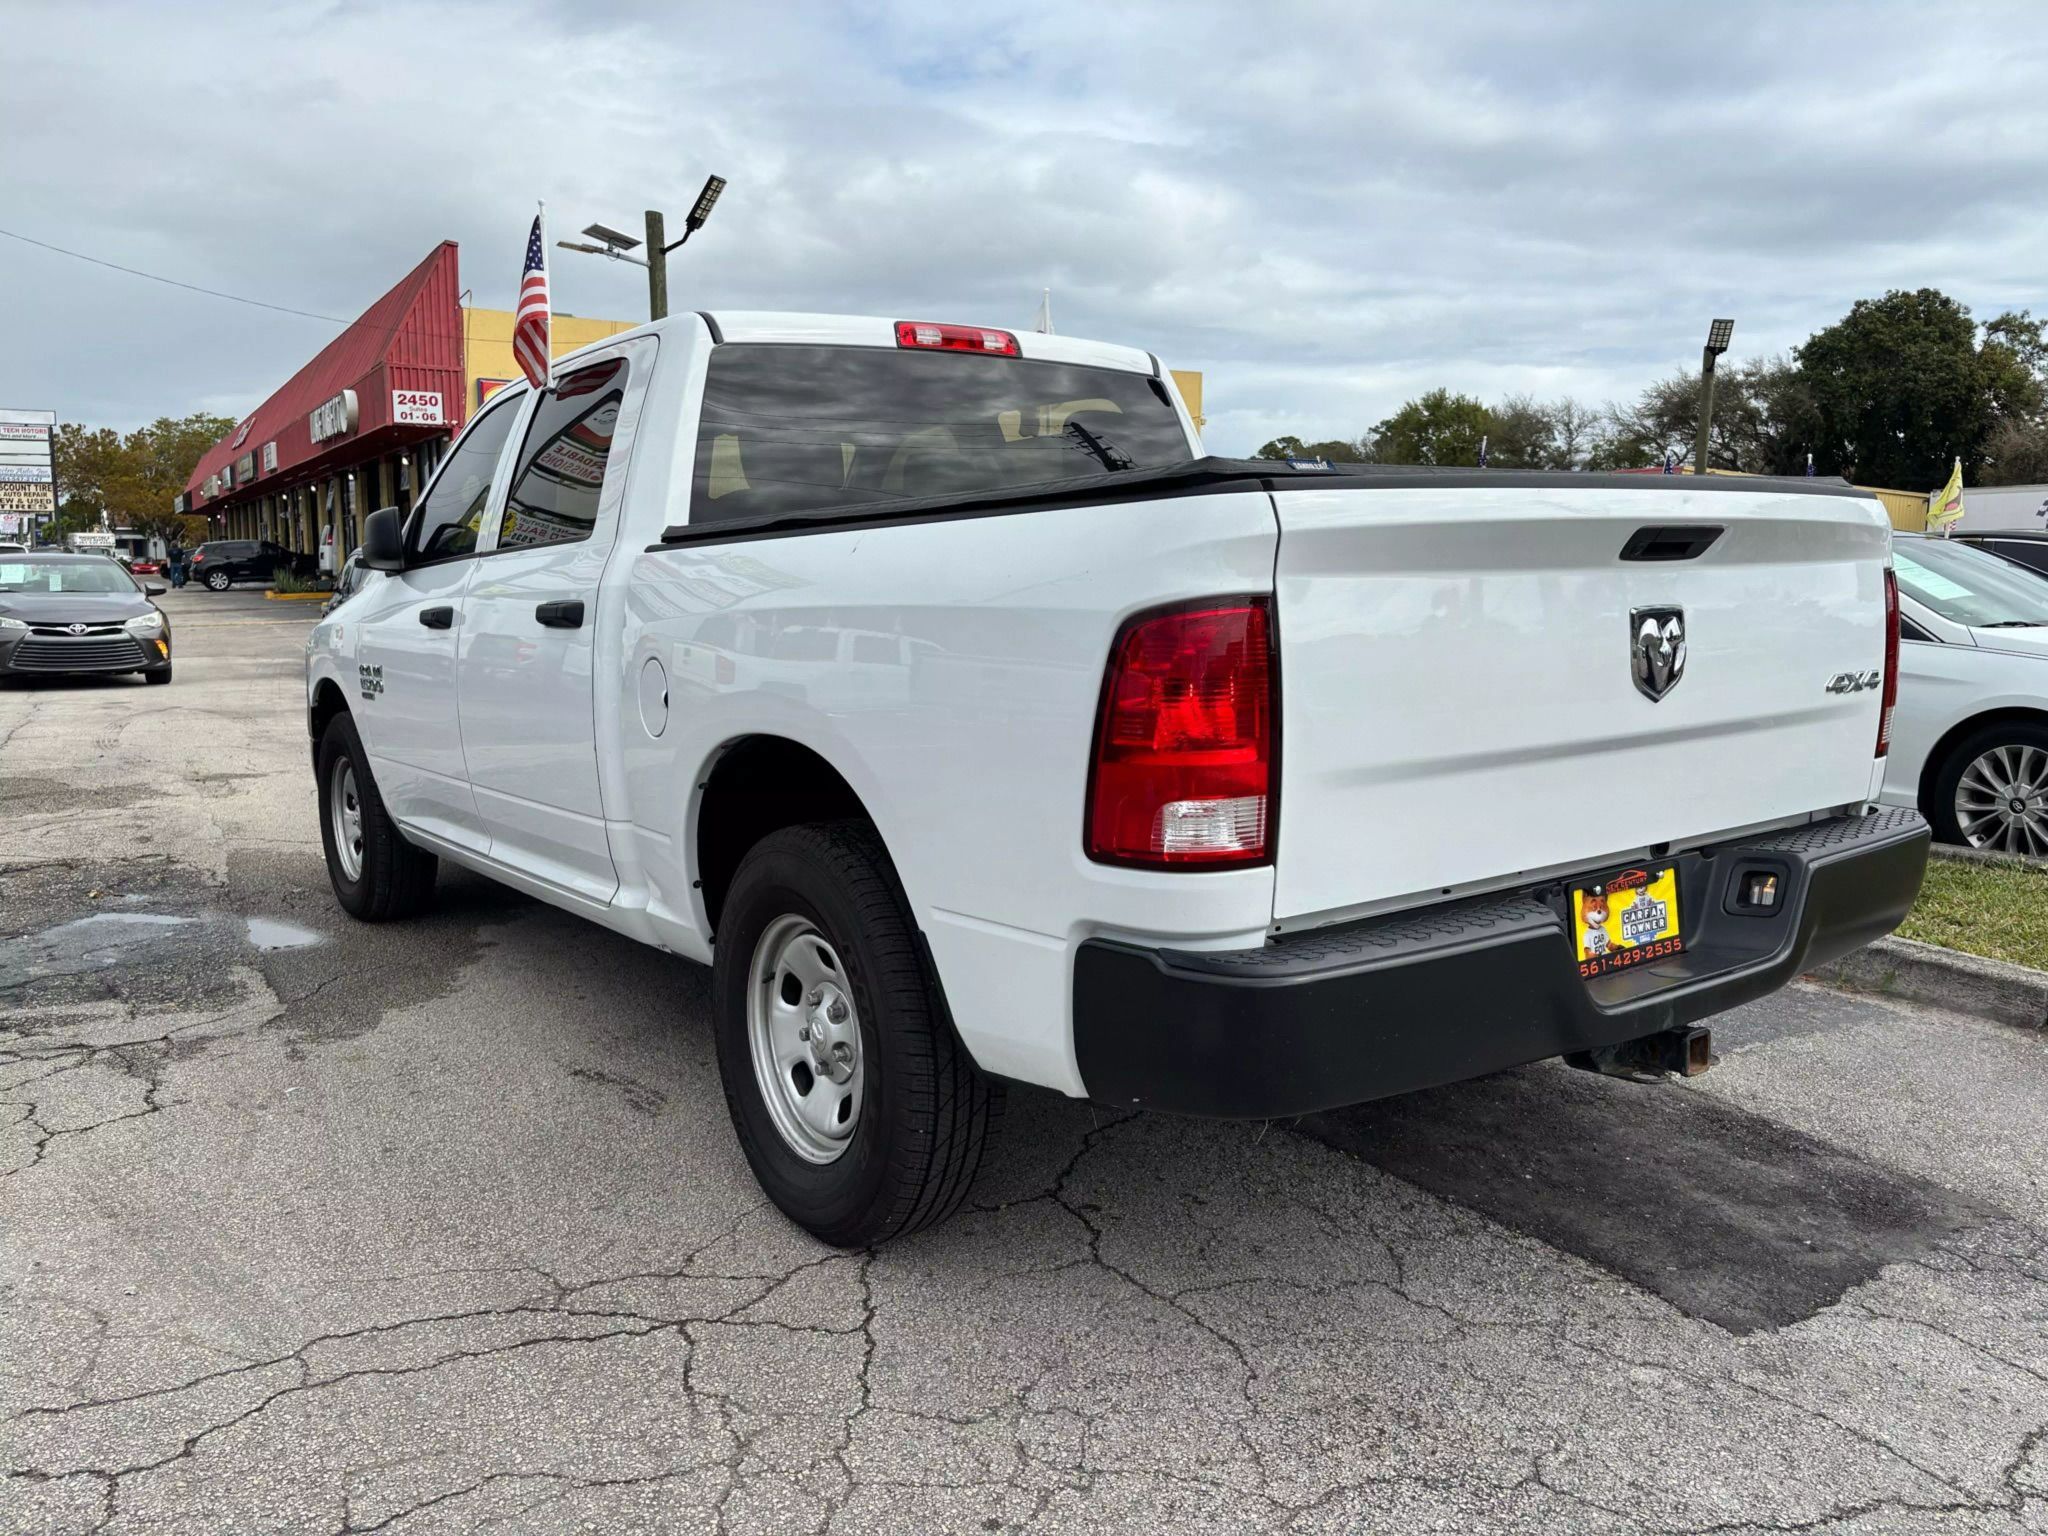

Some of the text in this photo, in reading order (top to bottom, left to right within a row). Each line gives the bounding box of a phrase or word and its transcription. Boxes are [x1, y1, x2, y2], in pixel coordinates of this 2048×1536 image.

[397, 394, 439, 407] 2450
[34, 484, 53, 492] TIRE
[1623, 906, 1665, 923] CARFAX
[1631, 918, 1665, 935] OWNER
[1593, 933, 1605, 945] CAR
[1579, 938, 1682, 977] 561-429-2535
